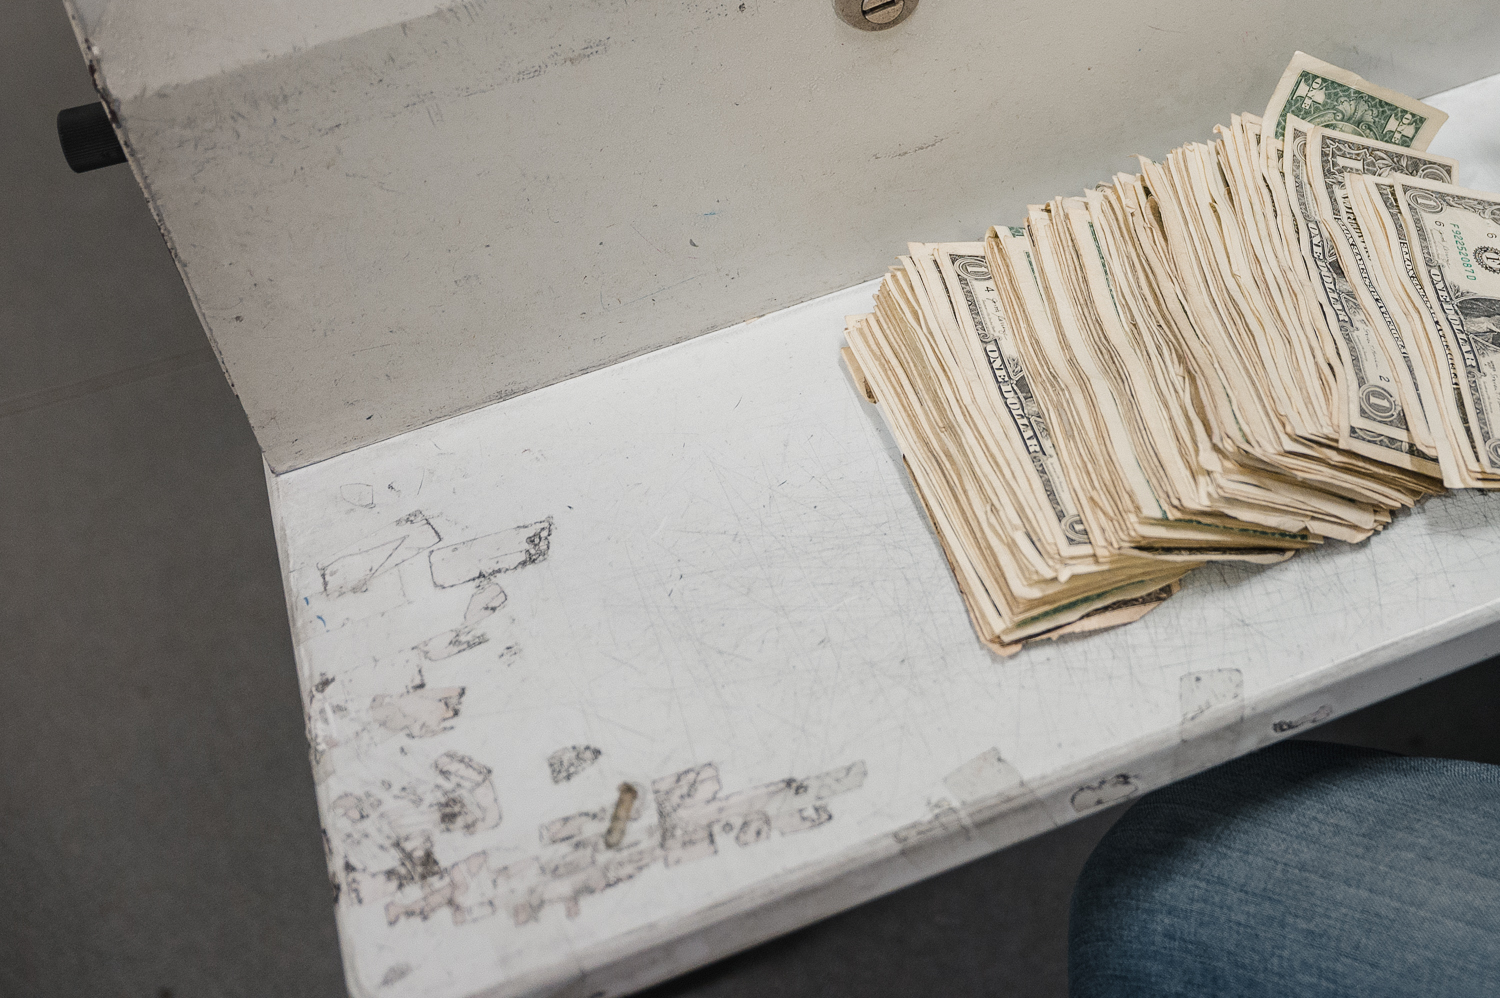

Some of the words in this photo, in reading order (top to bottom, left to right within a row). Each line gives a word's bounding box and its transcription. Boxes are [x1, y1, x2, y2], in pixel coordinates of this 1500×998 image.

[1306, 220, 1323, 259] ONE
[1316, 259, 1349, 322] DOLLAR
[1430, 269, 1451, 303] ONE
[1444, 302, 1477, 369] DOLLAR
[986, 344, 1013, 383] ONE
[1001, 381, 1042, 453] DOLLAR
